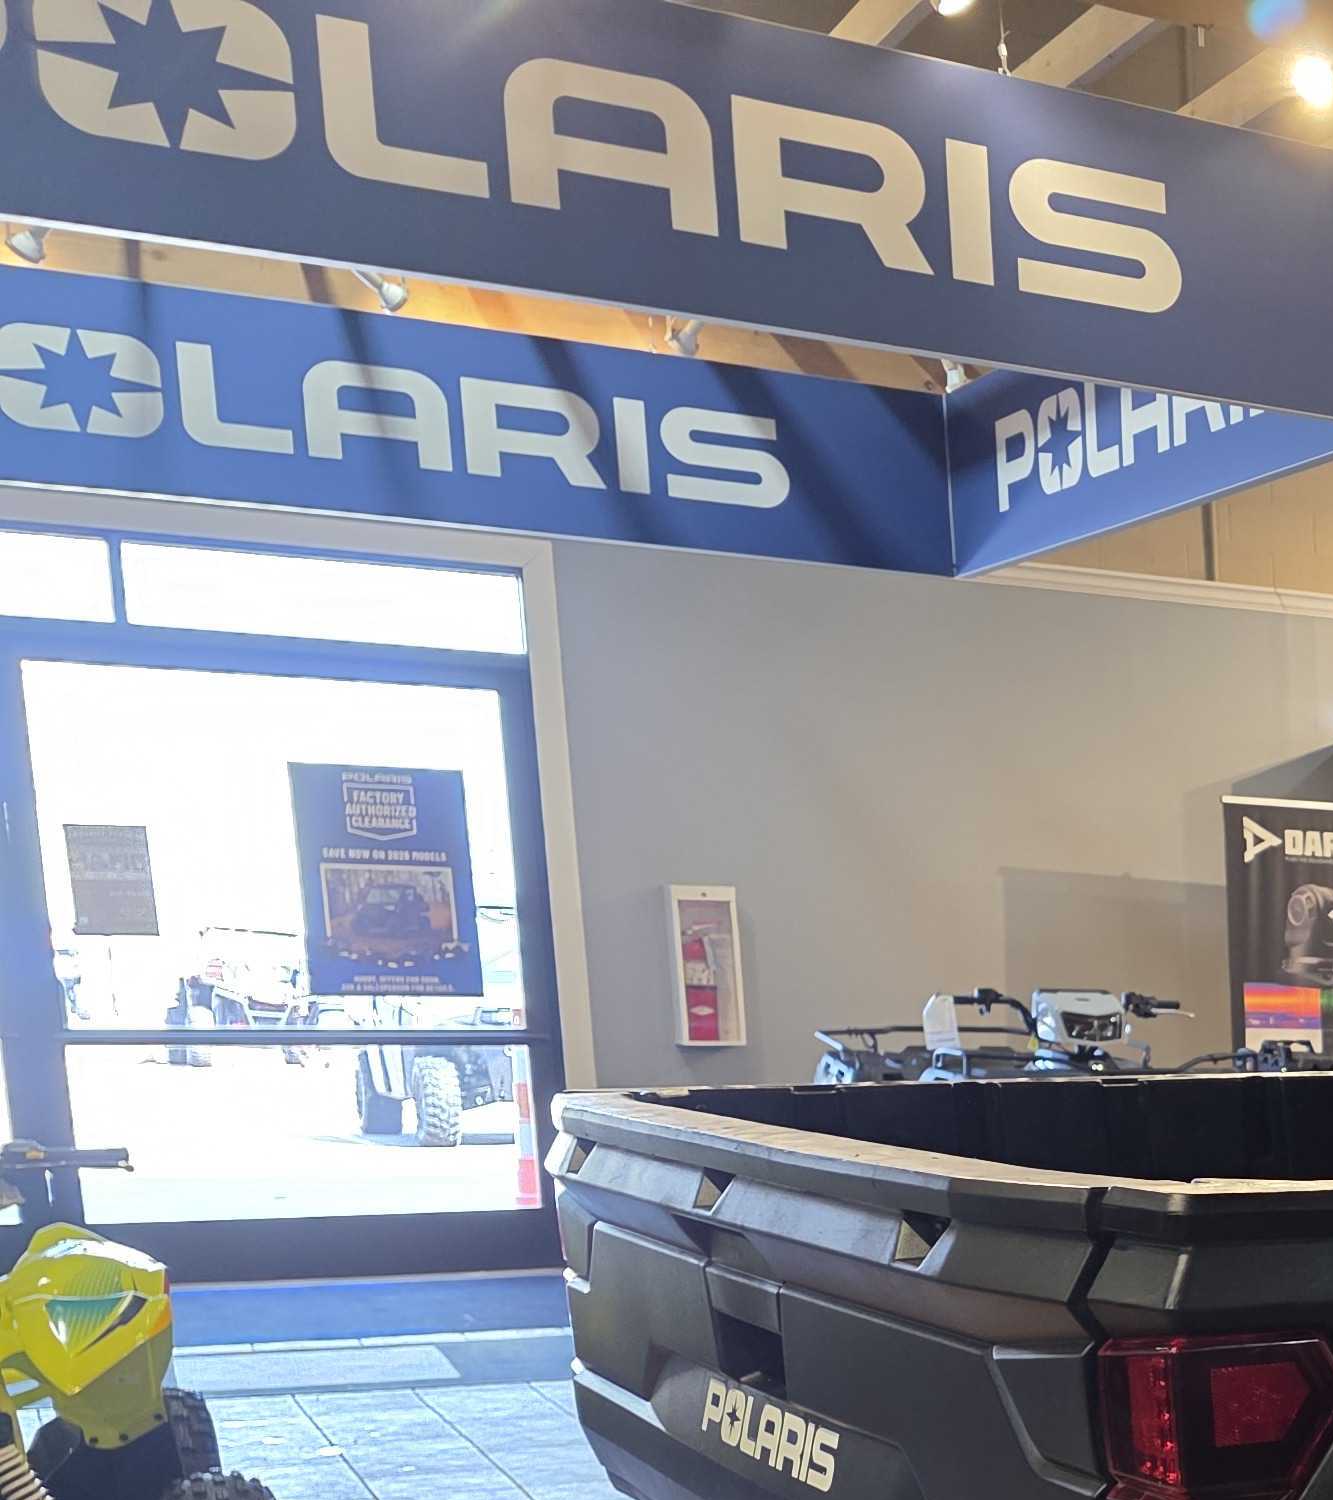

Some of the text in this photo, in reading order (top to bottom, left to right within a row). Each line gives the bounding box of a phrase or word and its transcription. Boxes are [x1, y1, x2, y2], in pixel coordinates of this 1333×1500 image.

[0, 0, 1182, 313] OLARIS
[346, 803, 416, 818] AUTHORIZED
[353, 789, 404, 804] FACTORY
[701, 1377, 840, 1493] POLARIS
